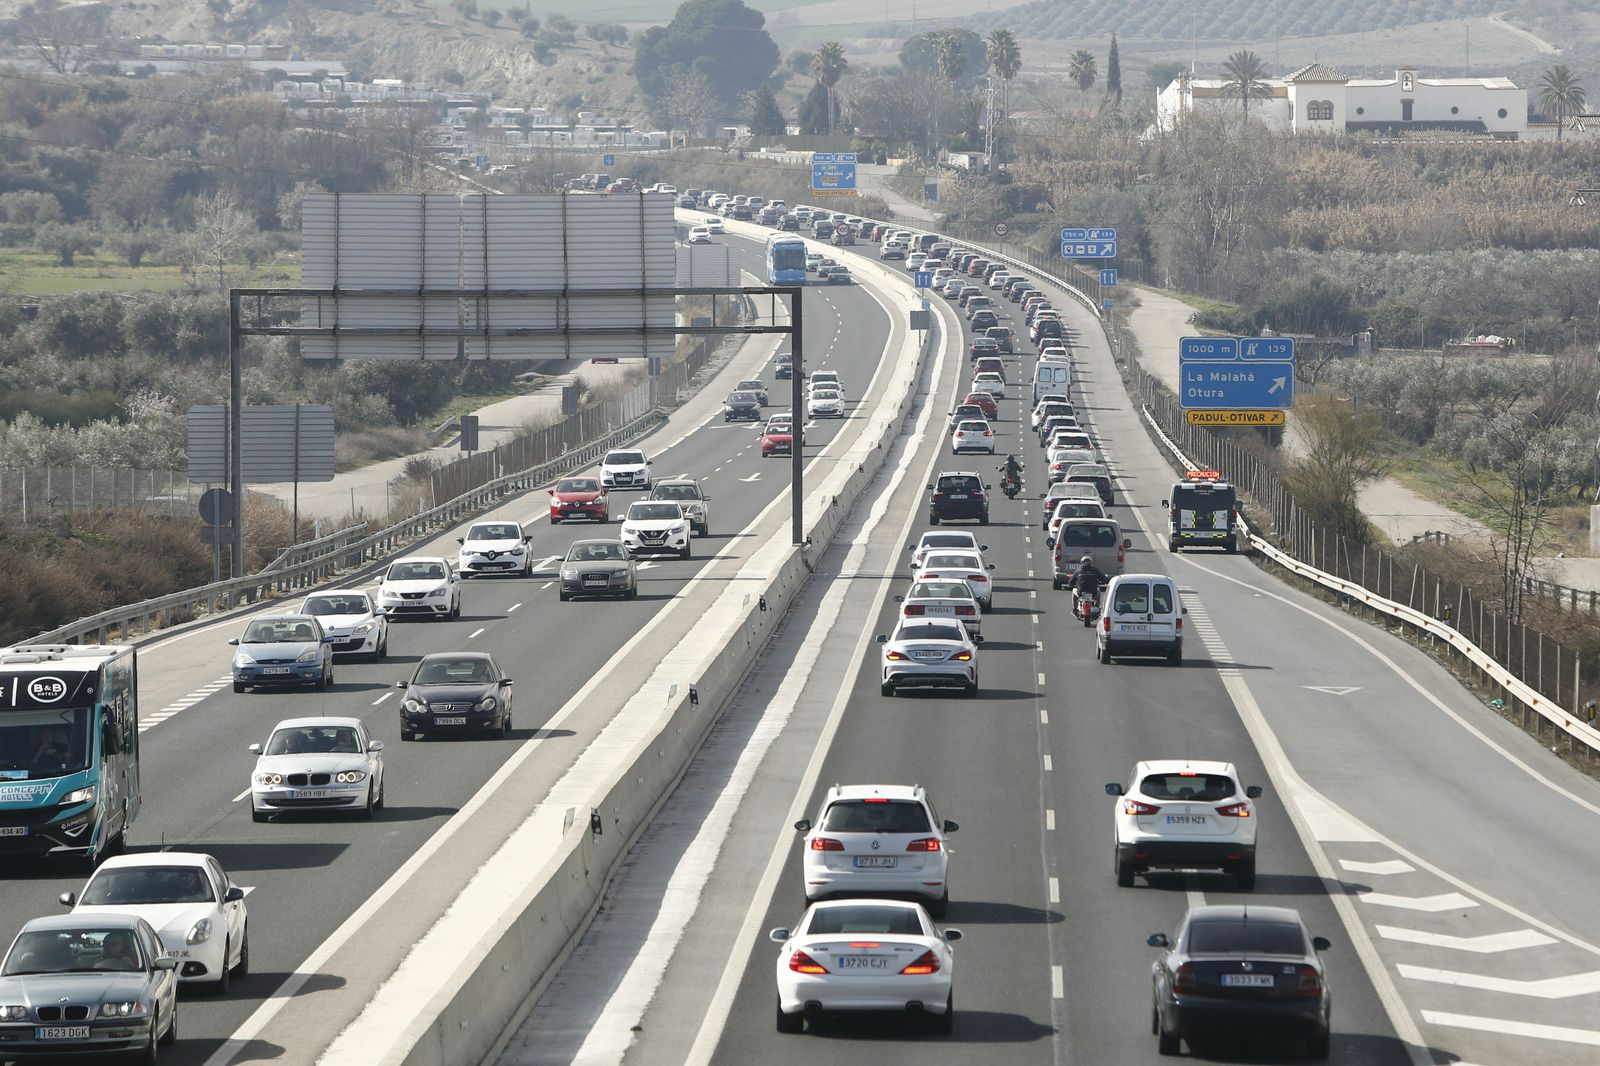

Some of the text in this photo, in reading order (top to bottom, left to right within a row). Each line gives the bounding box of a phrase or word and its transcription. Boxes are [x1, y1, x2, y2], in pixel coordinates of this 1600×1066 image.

[1188, 345, 1214, 353] 1000
[1268, 345, 1286, 353] 139
[1188, 371, 1255, 381] La Malahá
[1188, 388, 1224, 398] Otura
[33, 683, 62, 693] B&B
[1, 793, 33, 801] HOTELS
[1171, 816, 1206, 824] 5359 HZX
[845, 958, 888, 969] 3720 CJY
[1254, 975, 1273, 986] FMK
[42, 1026, 87, 1038] 1623 DGK
